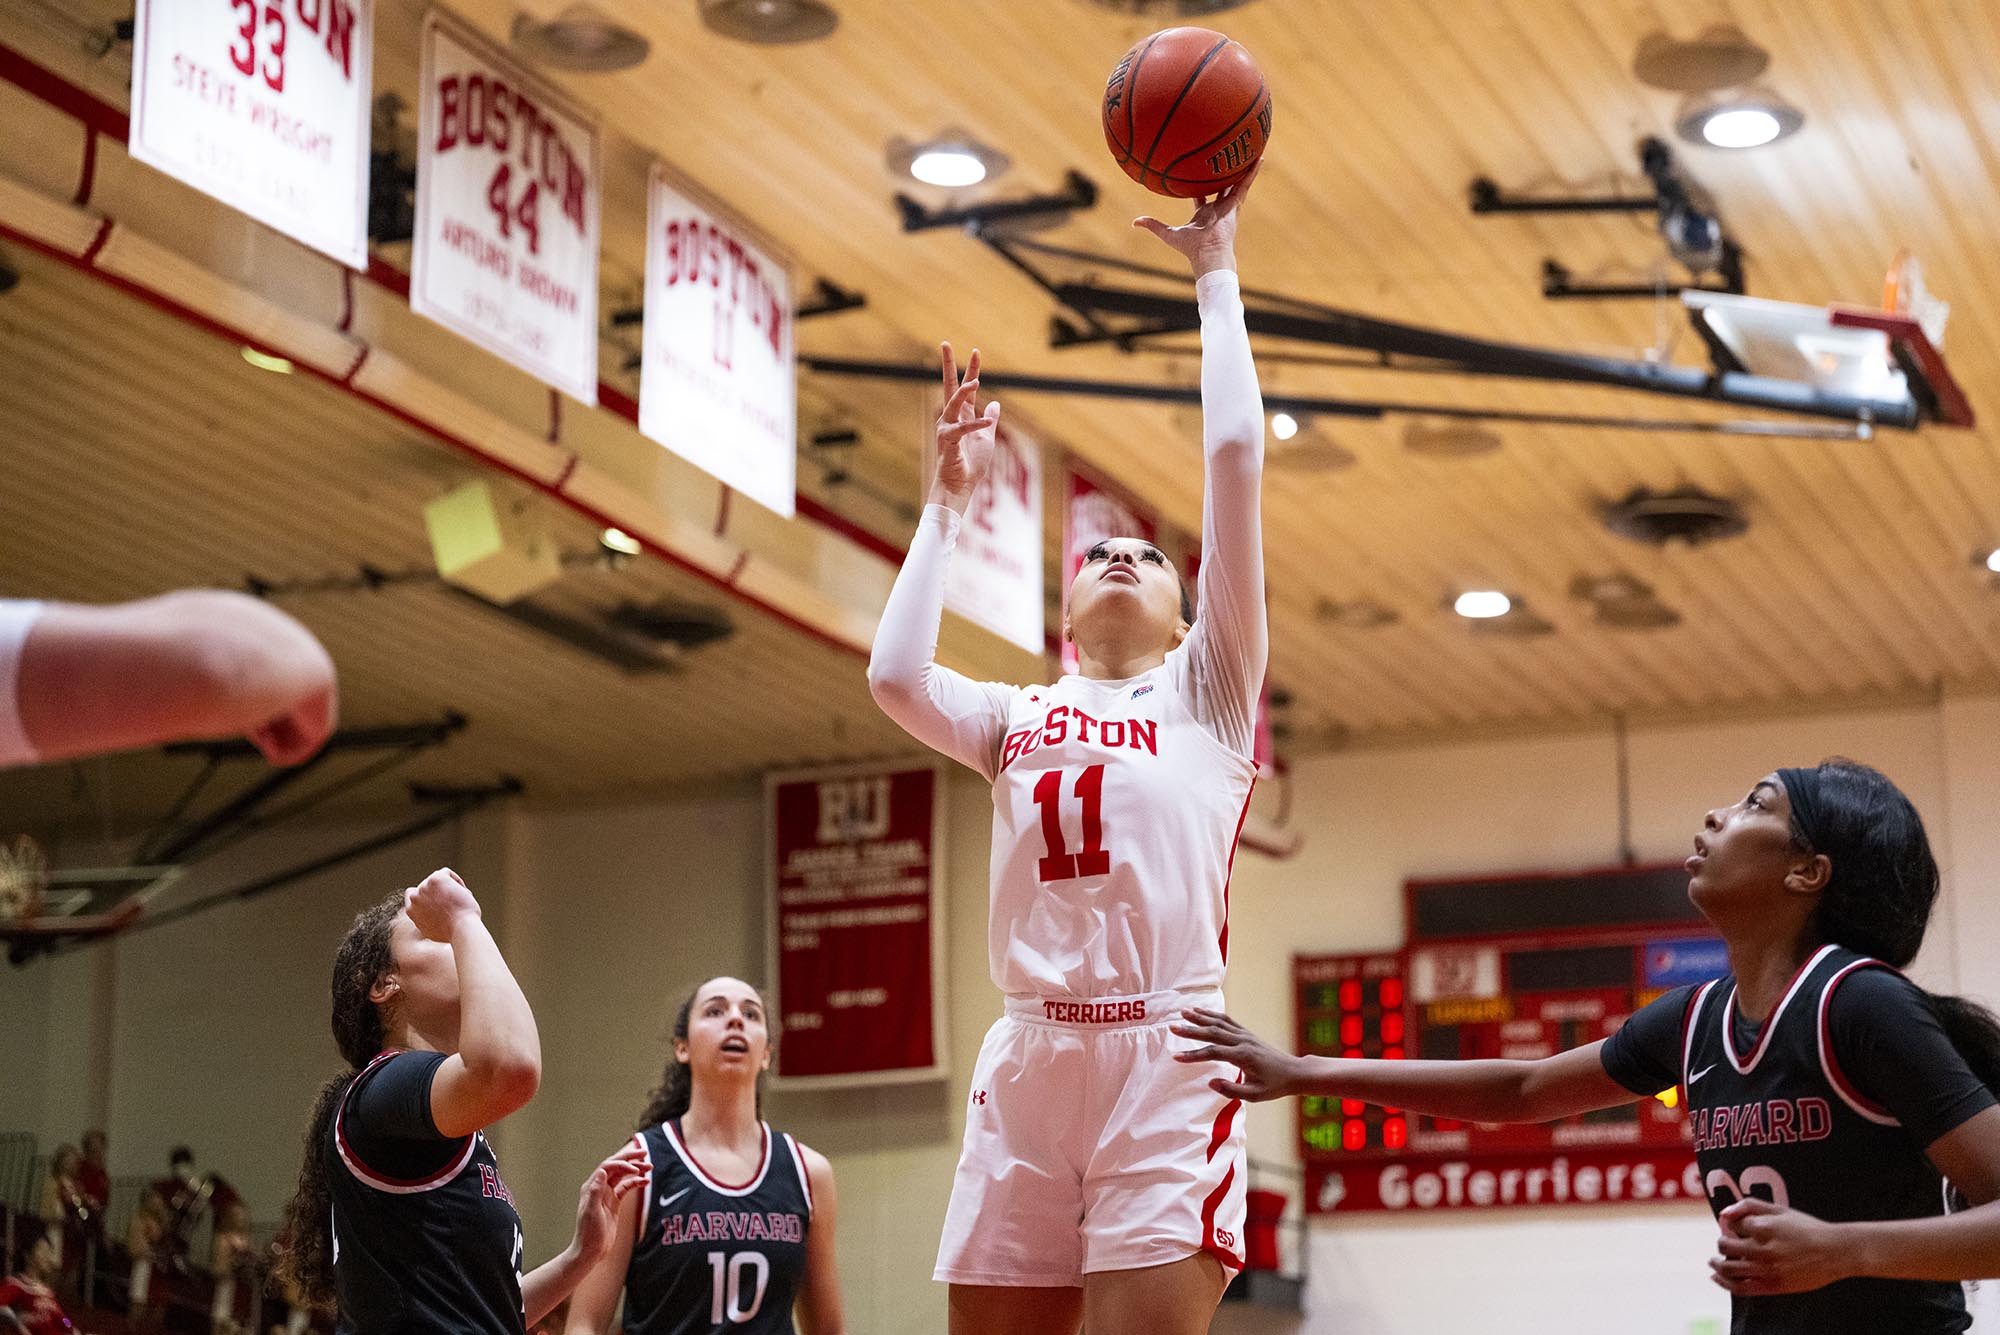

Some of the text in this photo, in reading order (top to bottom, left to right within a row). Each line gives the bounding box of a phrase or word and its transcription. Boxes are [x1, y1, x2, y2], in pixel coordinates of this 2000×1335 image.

[436, 73, 585, 238] BOSTON
[1206, 126, 1252, 174] THE
[486, 161, 538, 255] 44
[665, 218, 787, 368] BOSTON
[1000, 705, 1158, 774] BOSTON
[1033, 764, 1110, 882] 11
[1043, 1000, 1146, 1023] TERRIERS
[661, 1211, 803, 1245] HARVARD
[707, 1251, 770, 1325] 10
